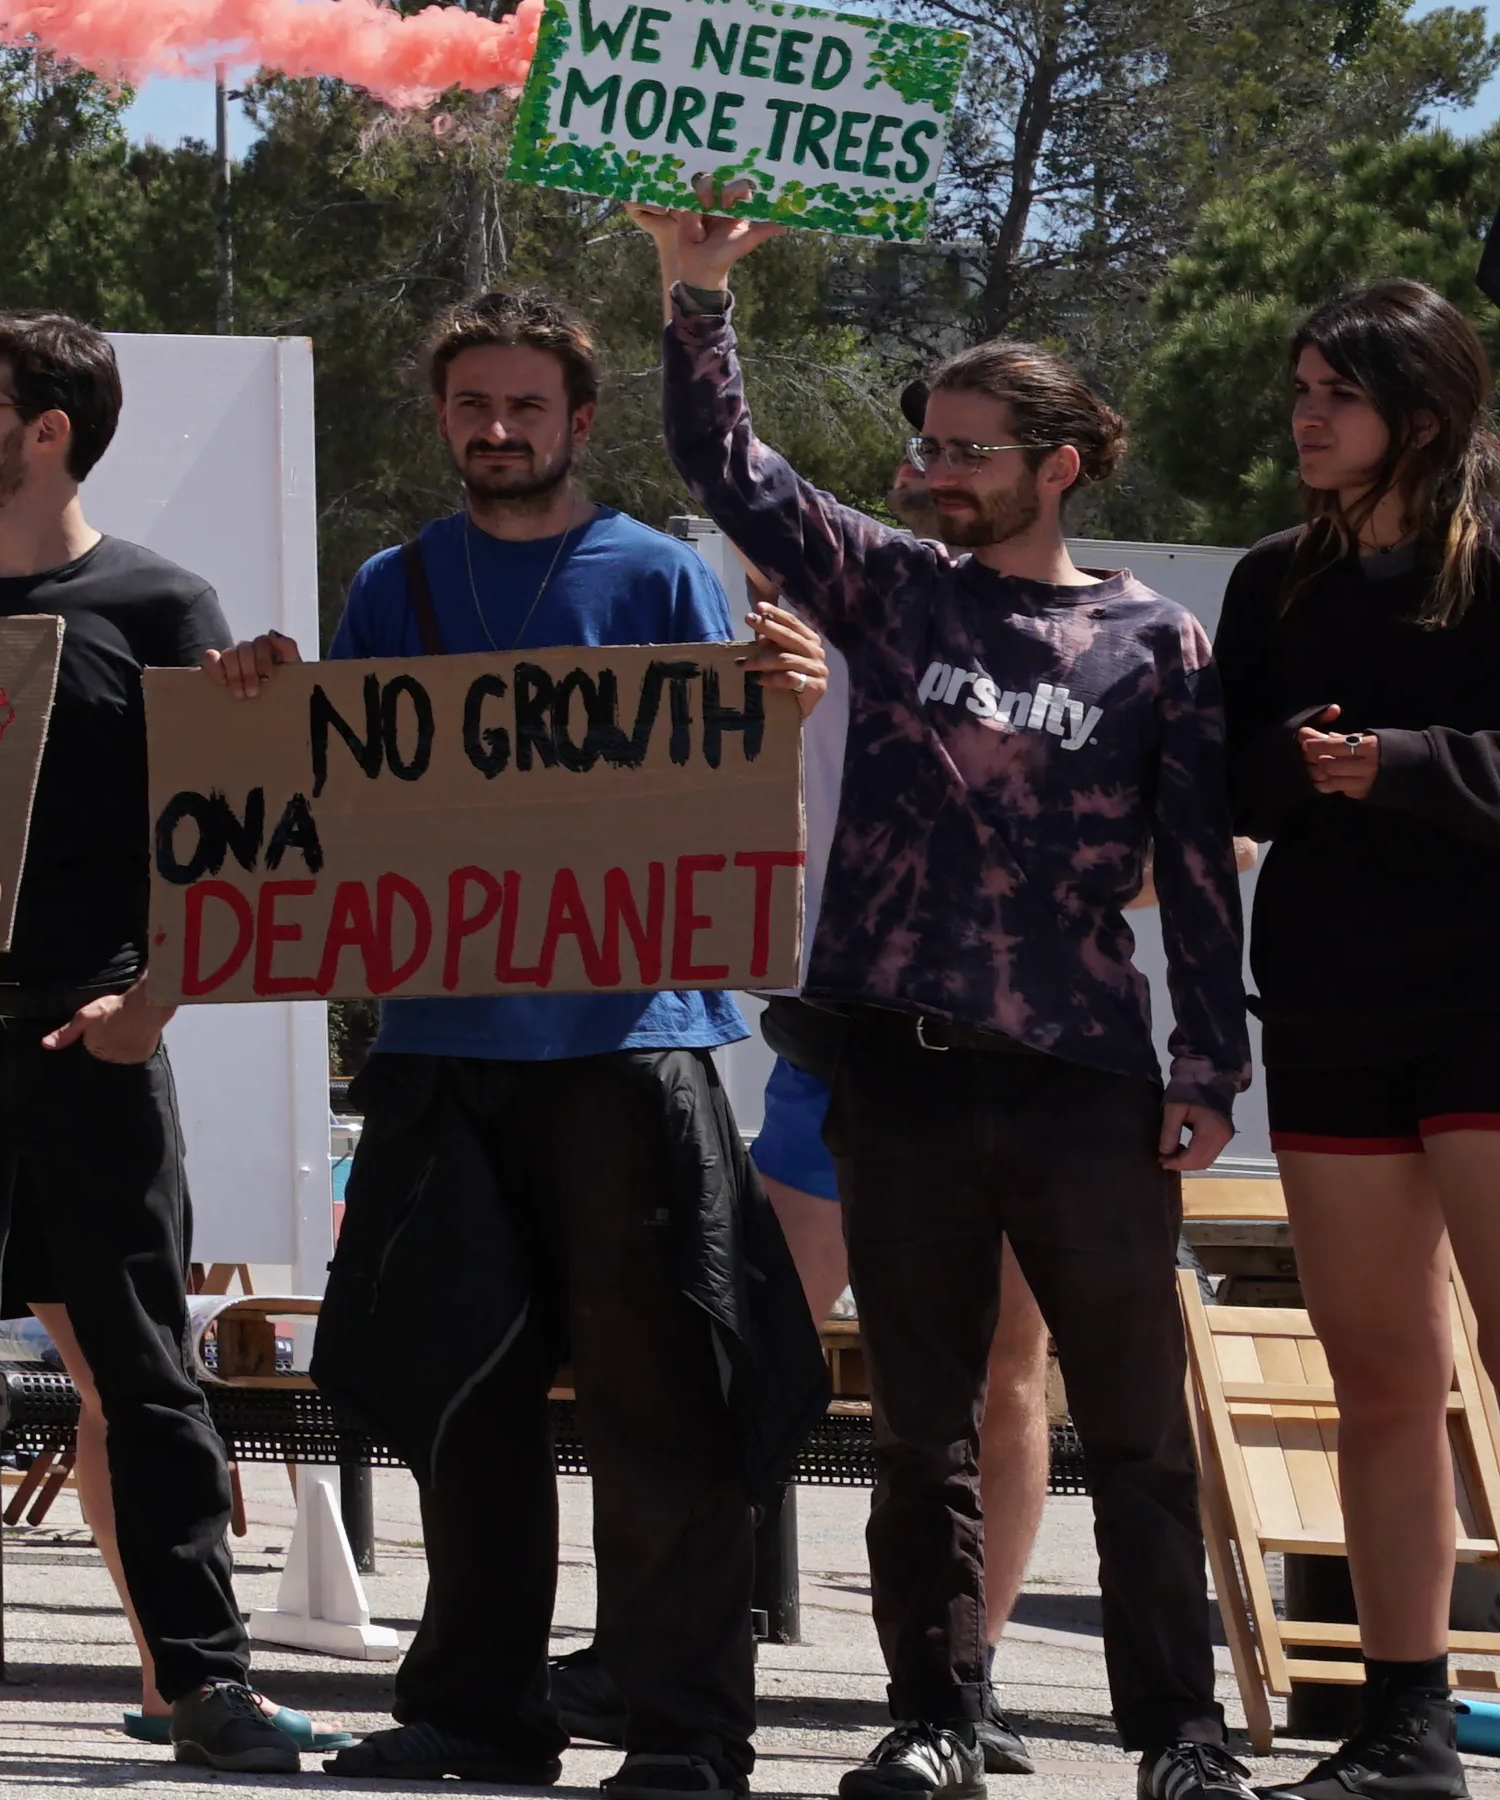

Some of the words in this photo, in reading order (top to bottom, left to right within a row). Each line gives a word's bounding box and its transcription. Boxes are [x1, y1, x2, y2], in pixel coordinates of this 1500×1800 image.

[692, 17, 852, 91] NEED
[559, 67, 745, 153] MORE
[765, 98, 939, 184] TREES
[309, 671, 435, 797] NO
[462, 660, 766, 780] GROWTH
[181, 871, 432, 997] DEAD
[443, 851, 806, 990] PLANET
